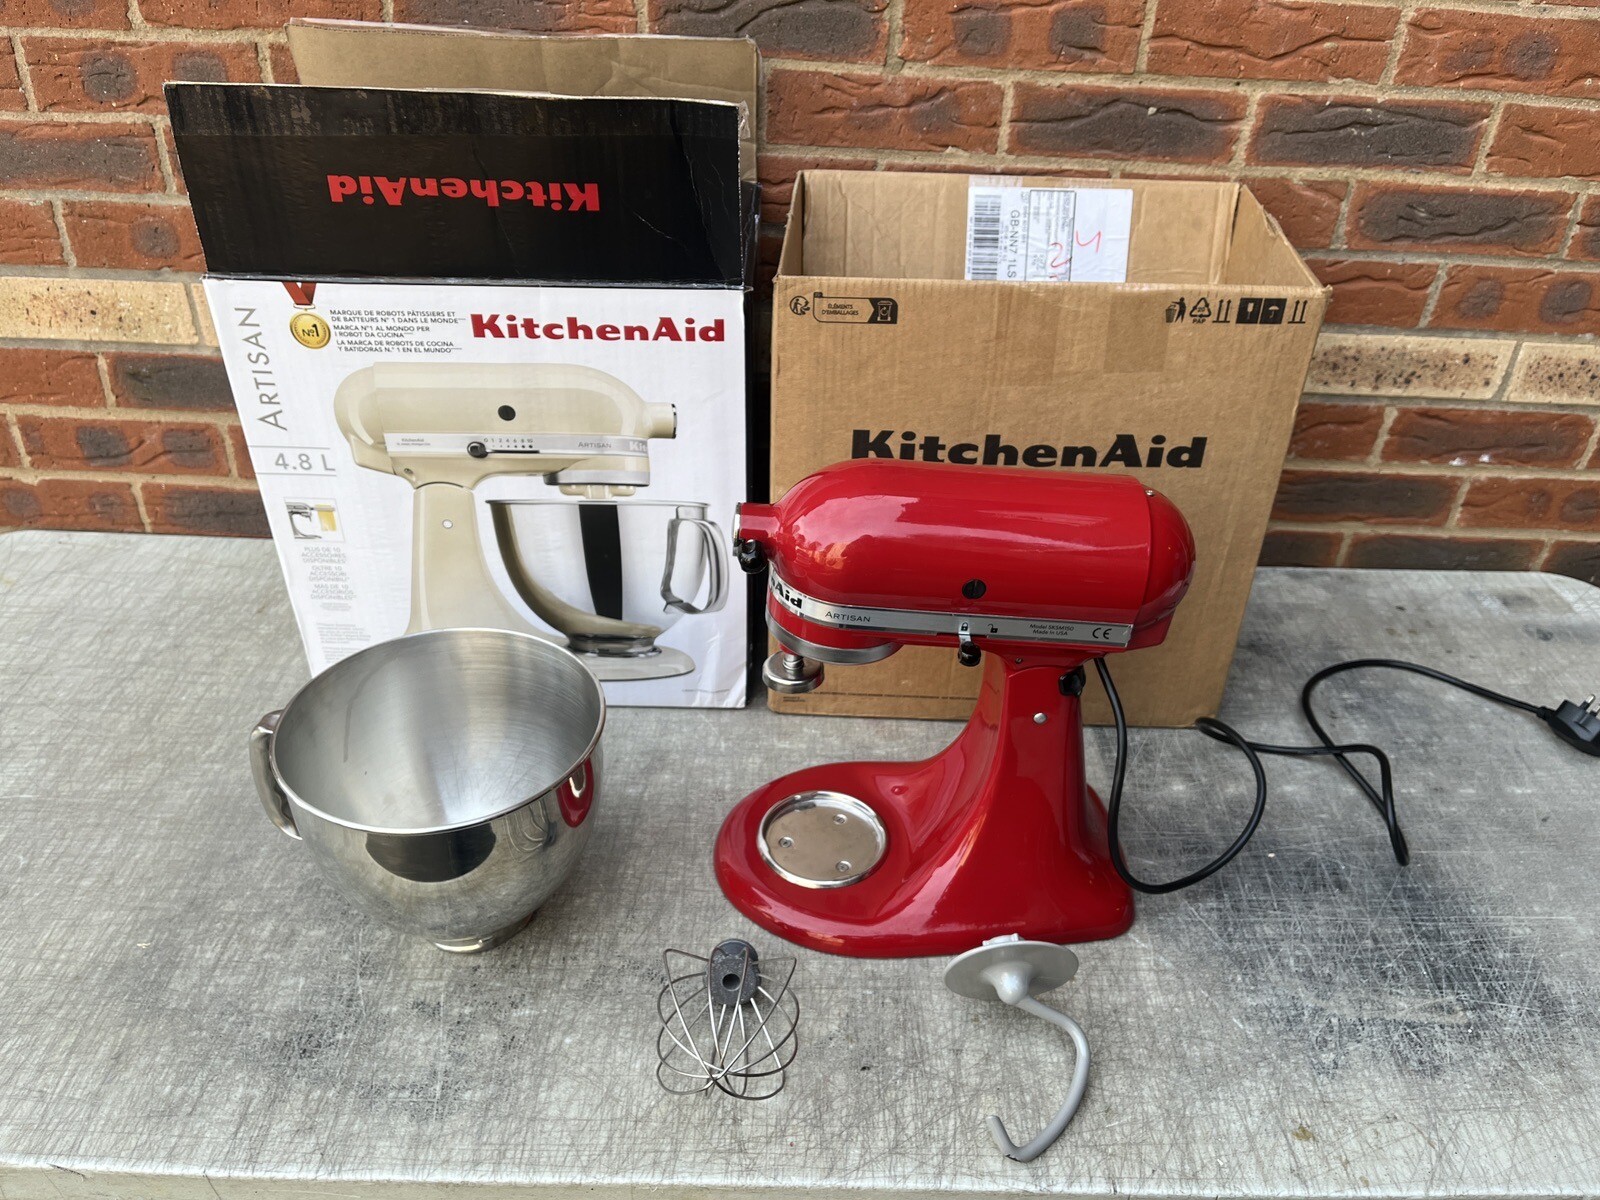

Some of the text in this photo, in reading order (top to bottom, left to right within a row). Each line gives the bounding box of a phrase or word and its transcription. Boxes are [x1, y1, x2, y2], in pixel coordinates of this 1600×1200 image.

[327, 174, 600, 212] KitchenAid
[1009, 209, 1021, 254] GB-NN7
[329, 309, 363, 317] MARQUE
[470, 313, 725, 342] KitchenAid
[234, 307, 288, 431] ARTISAN
[577, 441, 612, 449] ARTISAN
[851, 429, 1208, 468] KitchenAid
[275, 452, 336, 472] 4.8 L
[825, 611, 871, 622] ARTISAN
